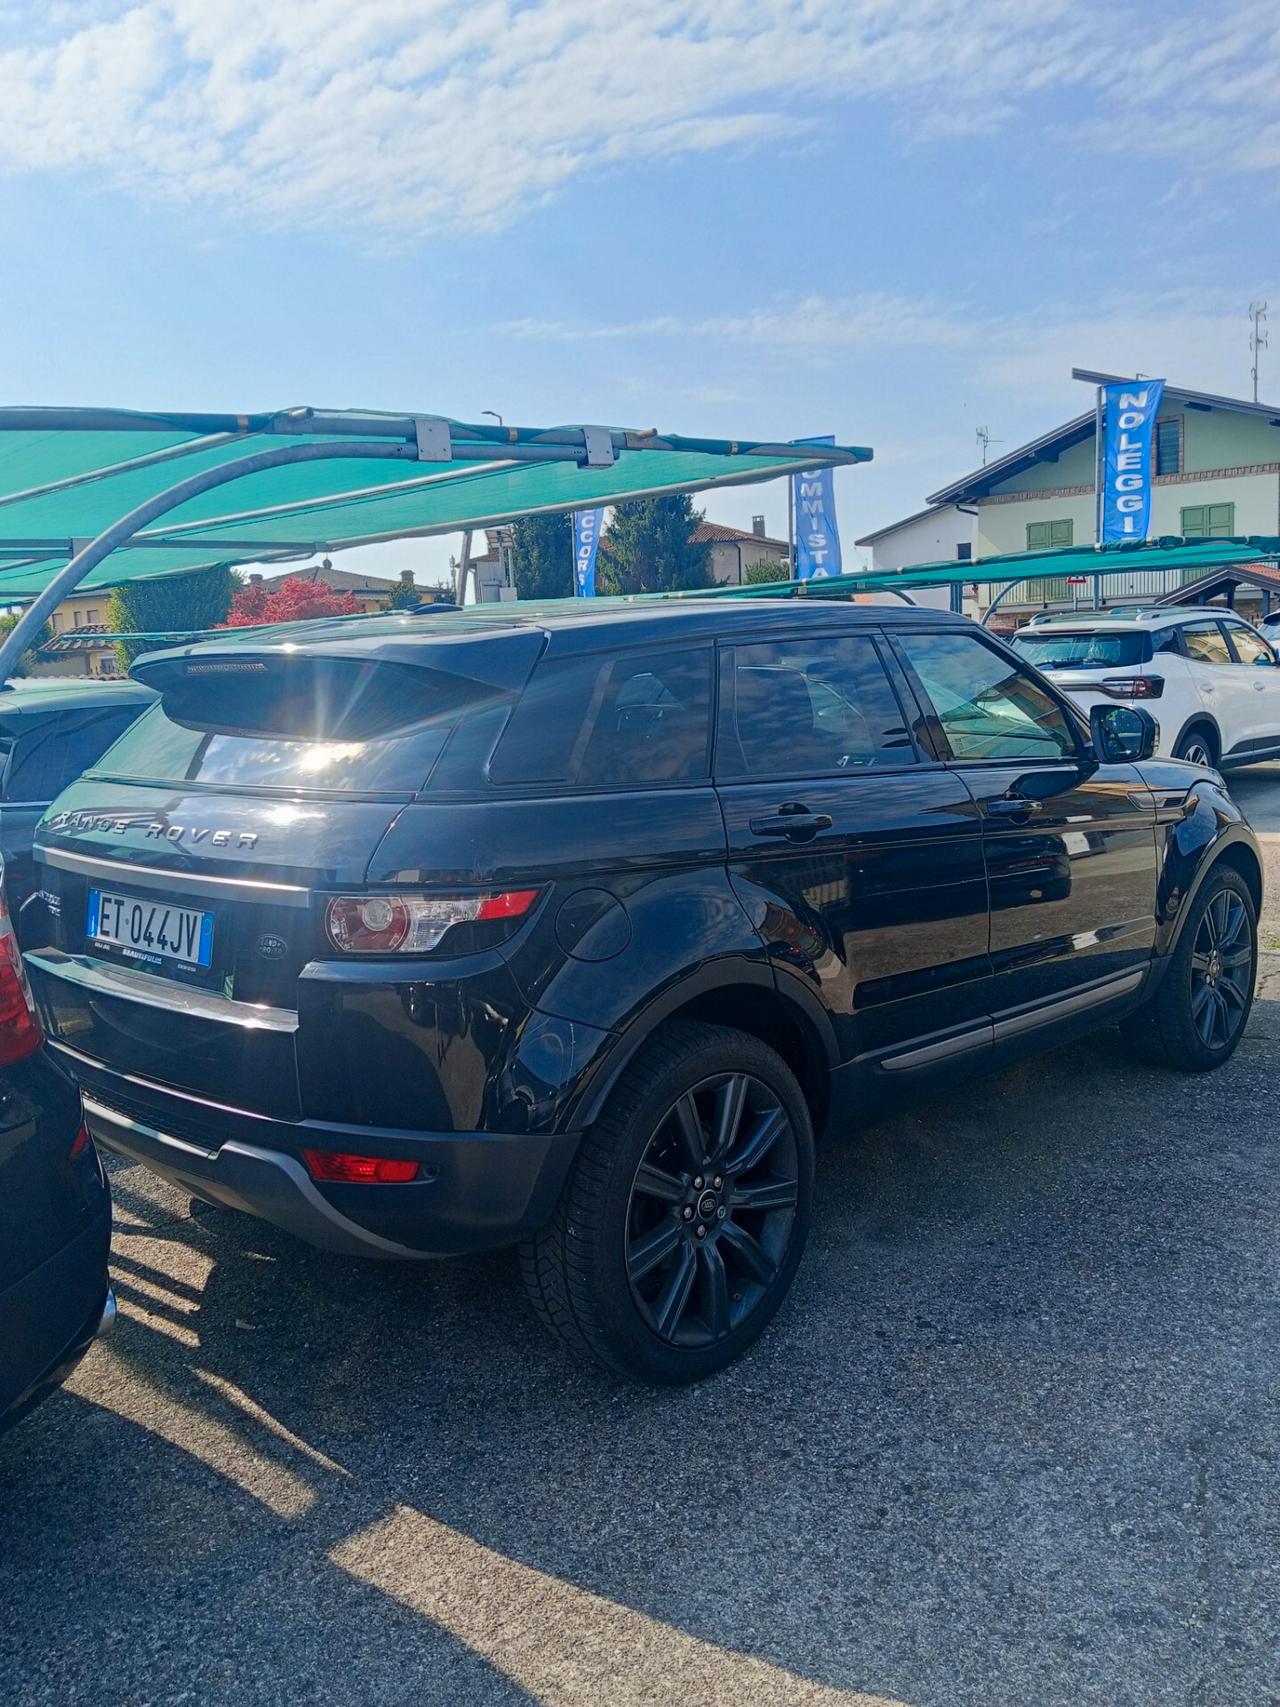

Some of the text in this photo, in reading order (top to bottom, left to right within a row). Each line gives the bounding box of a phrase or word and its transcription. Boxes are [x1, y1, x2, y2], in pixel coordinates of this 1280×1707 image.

[1115, 391, 1147, 541] NOLEGGI
[577, 510, 594, 598] CCORS
[56, 810, 259, 849] RANGE ROVER
